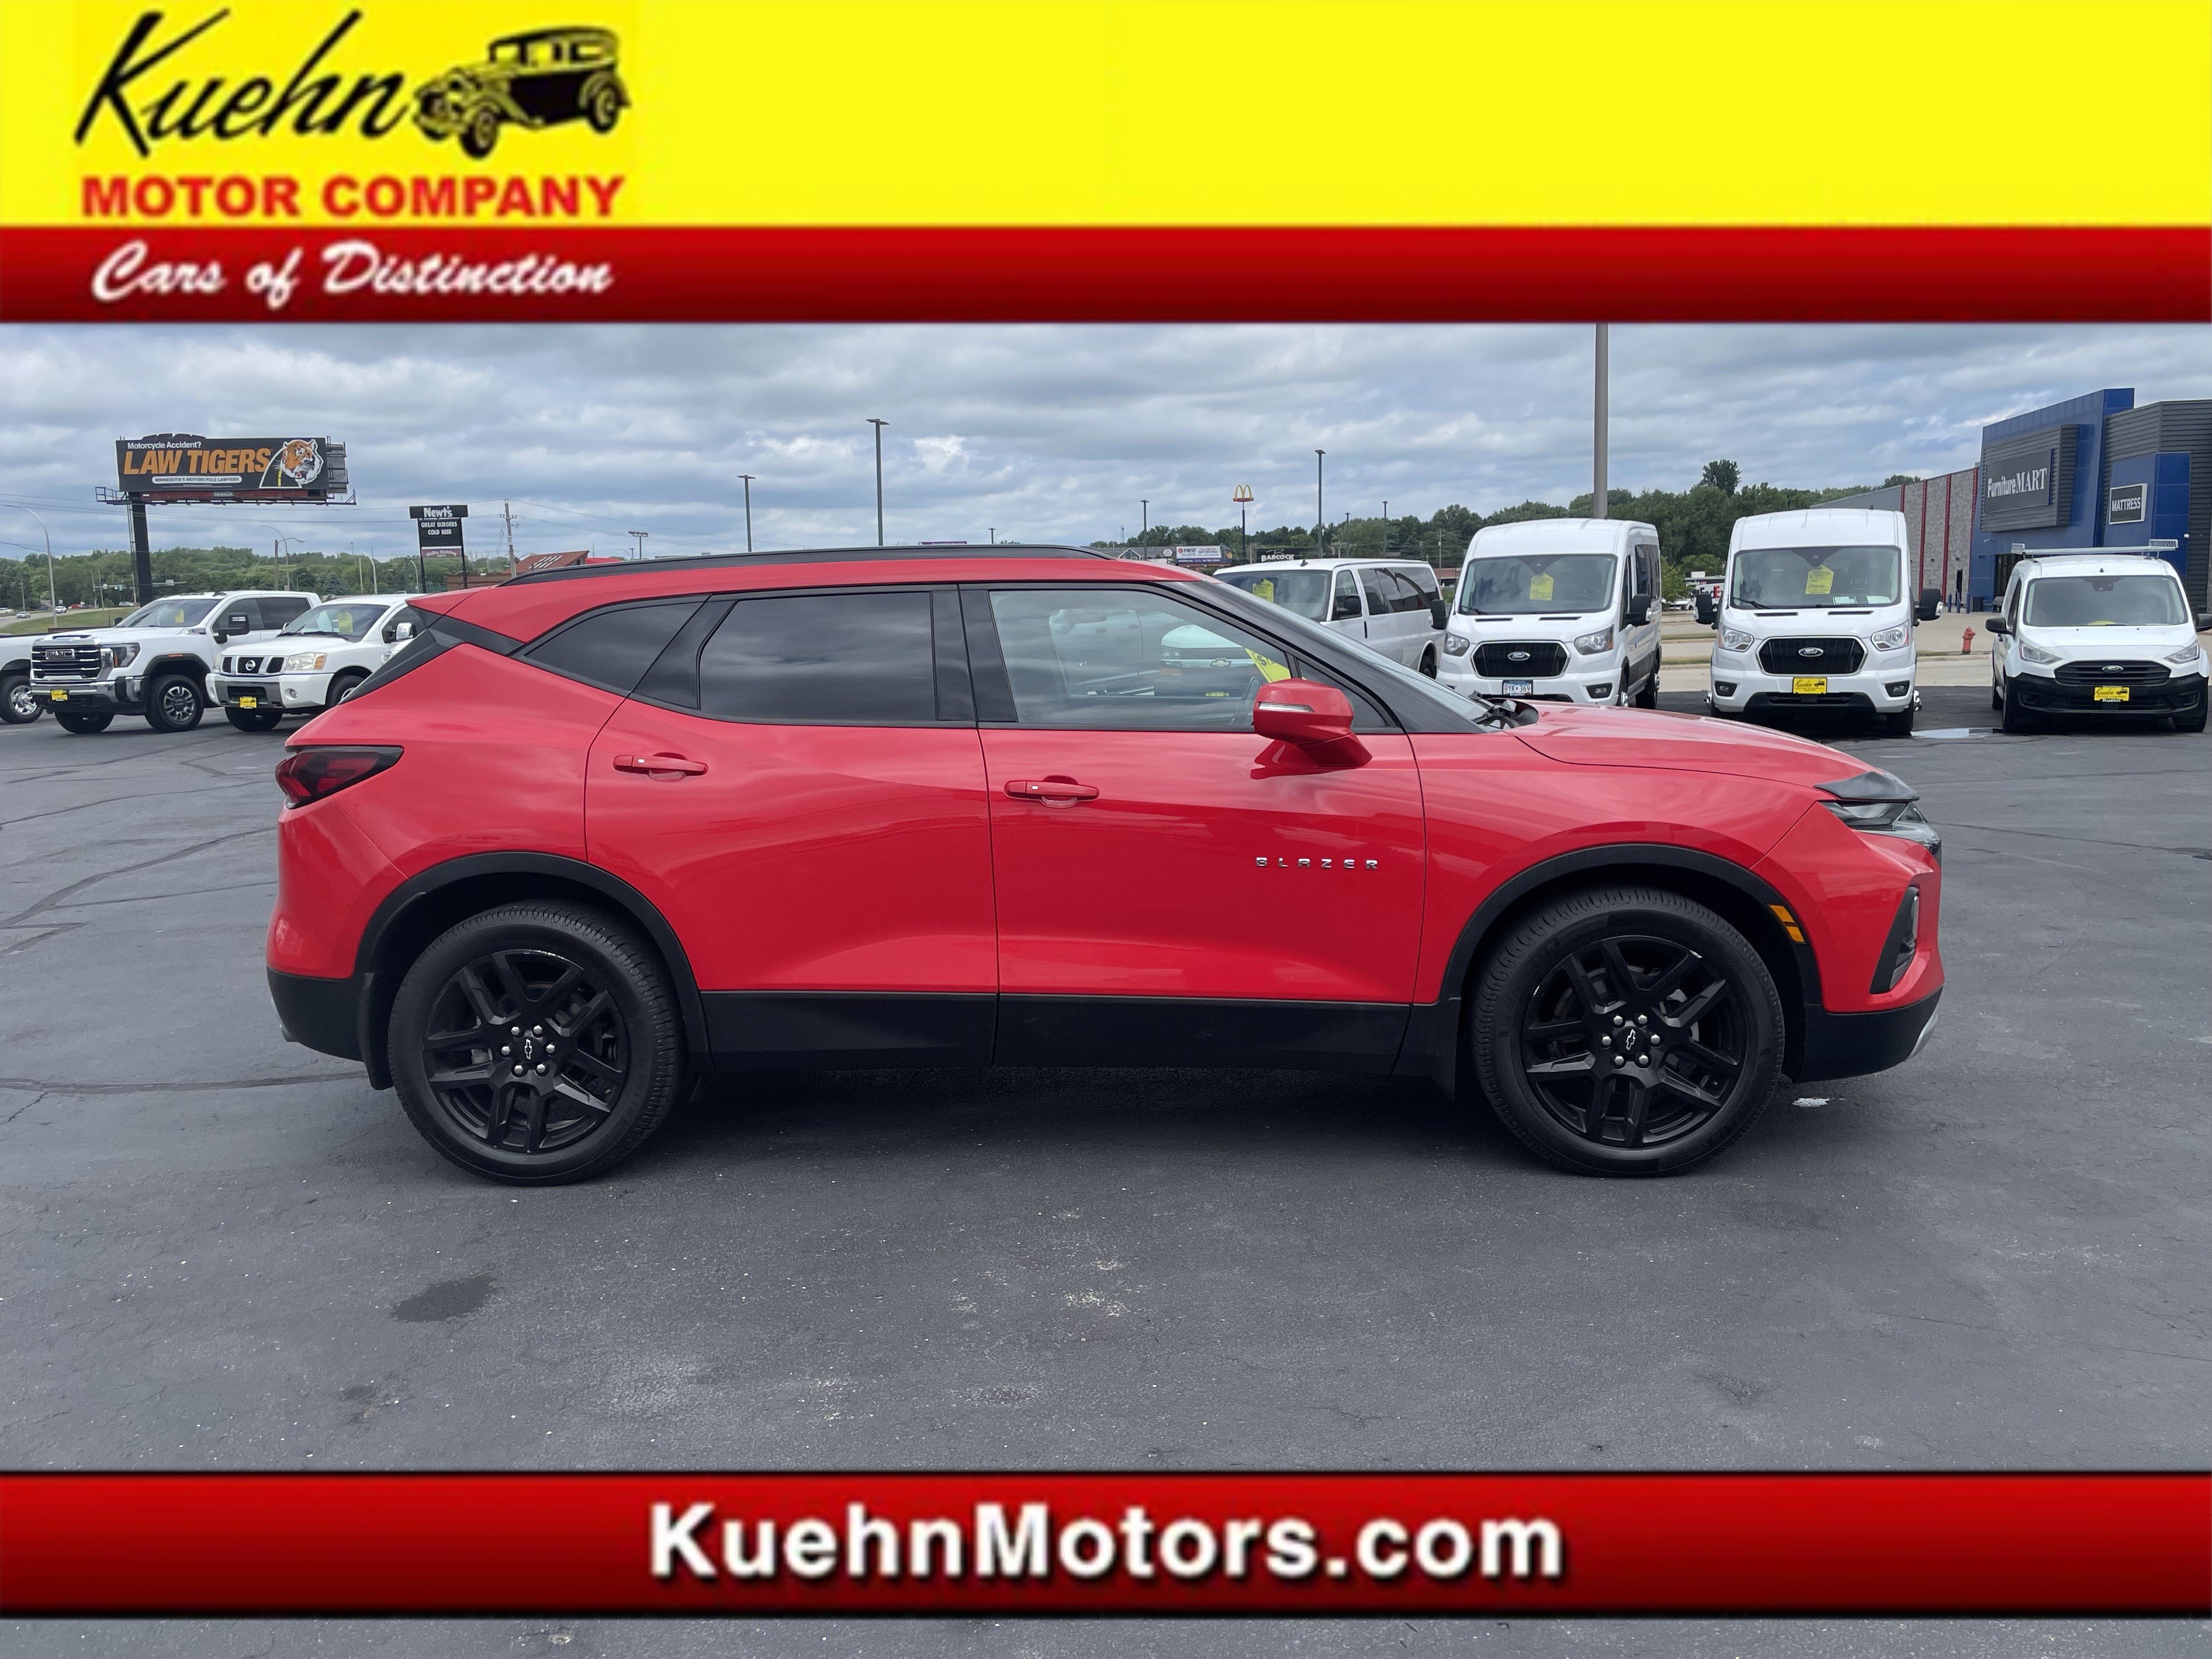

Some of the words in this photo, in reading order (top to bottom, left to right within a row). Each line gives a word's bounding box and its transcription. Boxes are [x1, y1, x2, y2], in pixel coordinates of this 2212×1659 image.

[127, 441, 165, 450] Motorcycle
[124, 450, 183, 475] LAW
[187, 448, 272, 474] TIGERS
[1987, 467, 2047, 498] FurnitureMART
[2112, 496, 2141, 511] MATTRESS
[424, 506, 453, 518] Newt's
[1256, 857, 1378, 870] BLAZER
